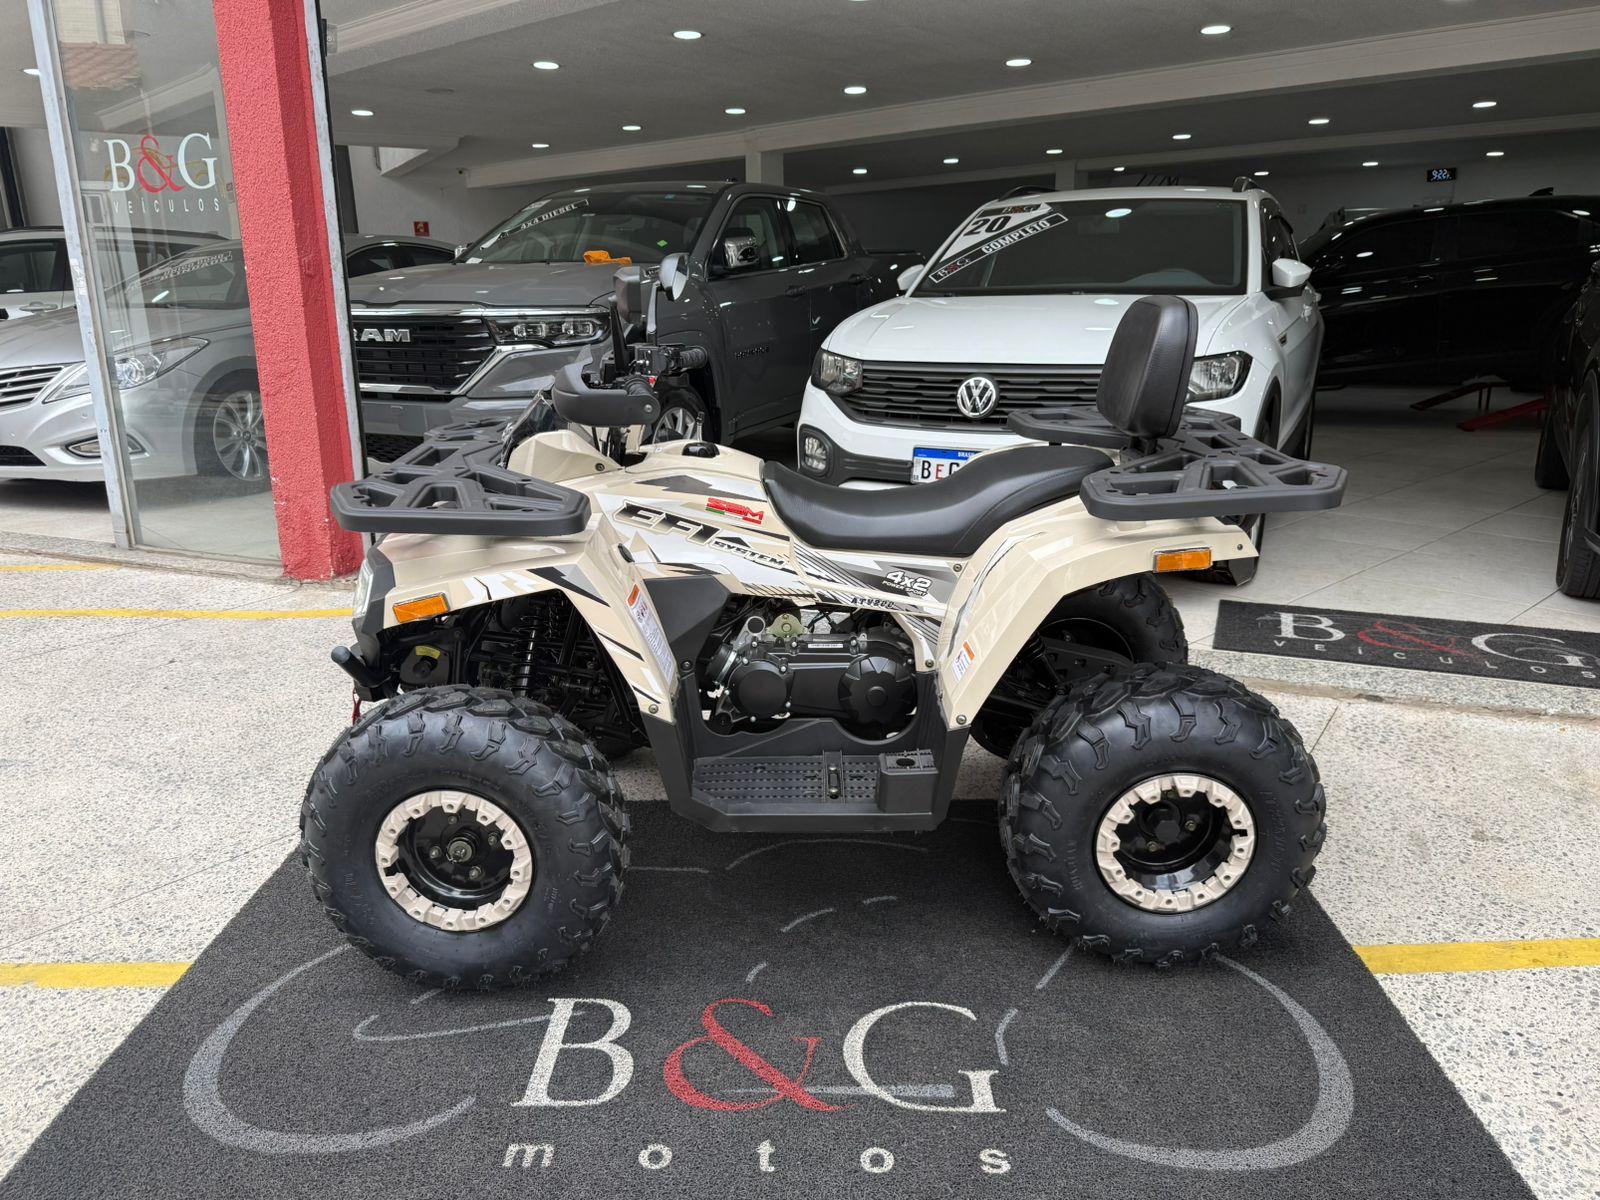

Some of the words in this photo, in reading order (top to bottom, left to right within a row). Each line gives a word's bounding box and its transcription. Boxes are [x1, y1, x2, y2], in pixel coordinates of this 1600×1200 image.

[103, 132, 218, 194] B&G
[113, 197, 220, 214] VEÍCULOS
[541, 203, 578, 221] DIESEL
[963, 215, 1011, 237] 20
[981, 219, 1051, 255] COMPLETO
[613, 500, 722, 546] EFI
[710, 539, 788, 567] SYSTEM
[886, 571, 932, 592] 4x2
[510, 997, 1008, 1113] B&G
[502, 1139, 1012, 1175] motos
